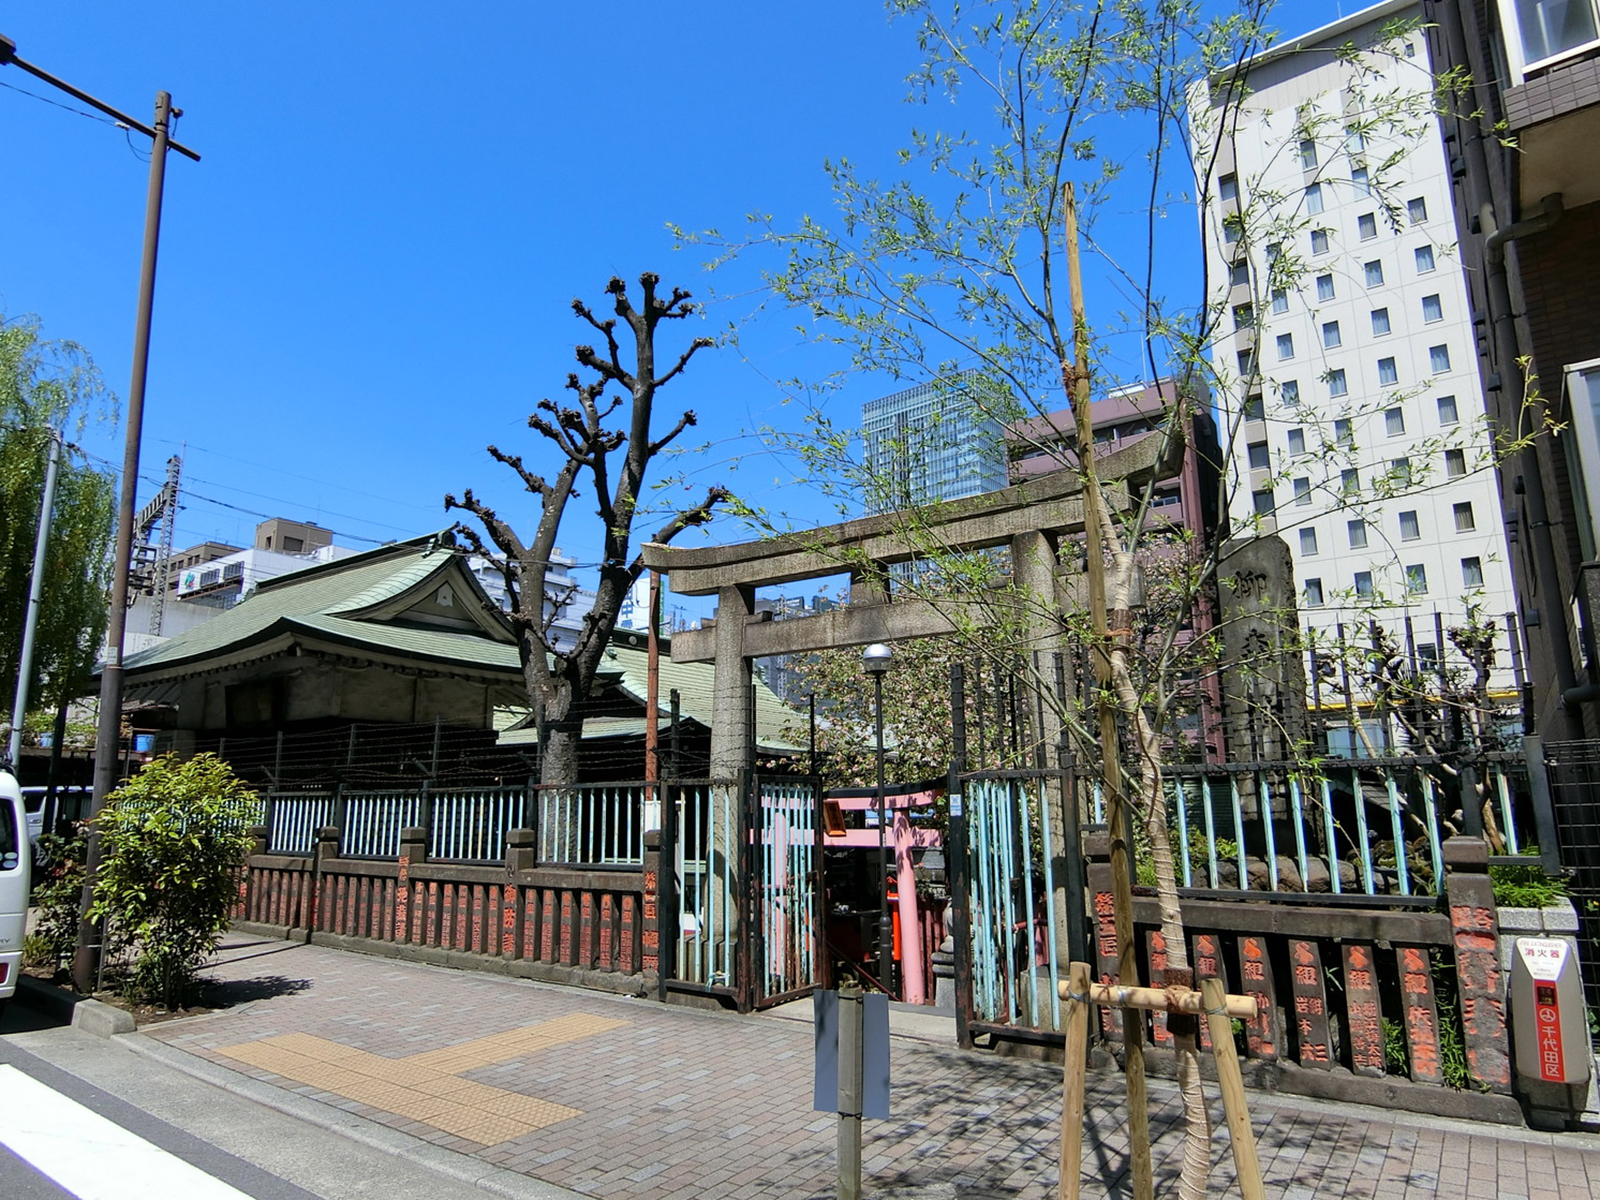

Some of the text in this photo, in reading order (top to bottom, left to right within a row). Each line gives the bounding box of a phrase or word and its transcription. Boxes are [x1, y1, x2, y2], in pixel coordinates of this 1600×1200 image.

[1525, 948, 1560, 958] 消火器
[1542, 1025, 1560, 1077] 千代田区
